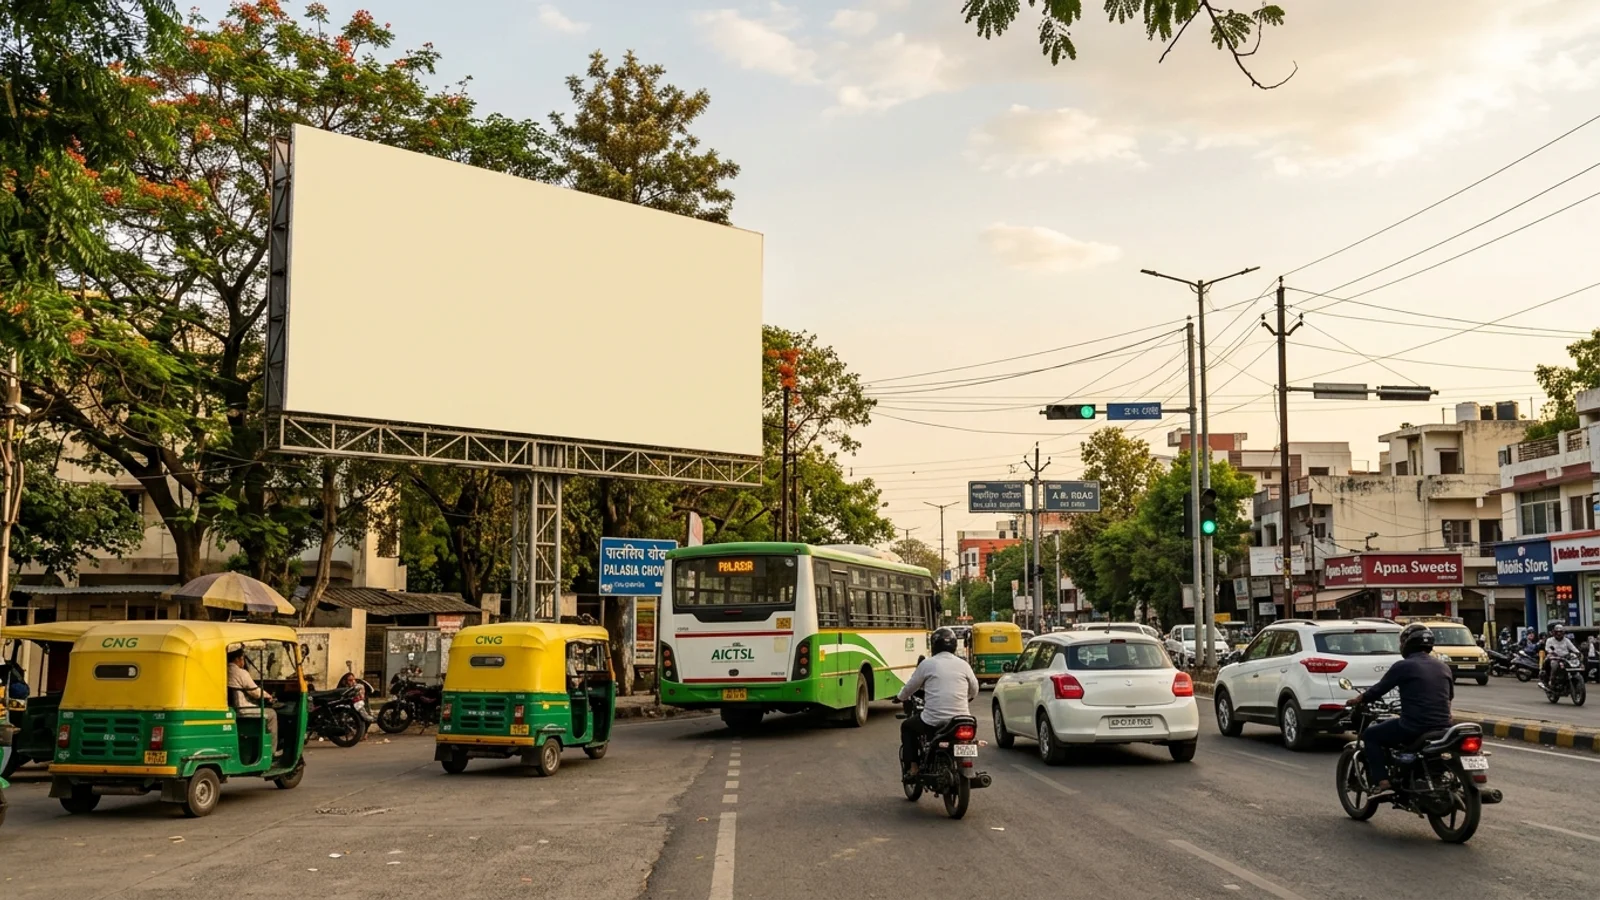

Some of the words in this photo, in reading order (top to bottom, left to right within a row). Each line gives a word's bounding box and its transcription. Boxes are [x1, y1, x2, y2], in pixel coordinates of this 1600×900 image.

[603, 564, 640, 576] PALASIA
[1373, 561, 1408, 577] Apna
[1411, 560, 1457, 573] Sweets
[1524, 558, 1549, 573] Store
[101, 637, 139, 648] CNG
[475, 635, 503, 645] CNG
[711, 648, 755, 660] AICTSL
